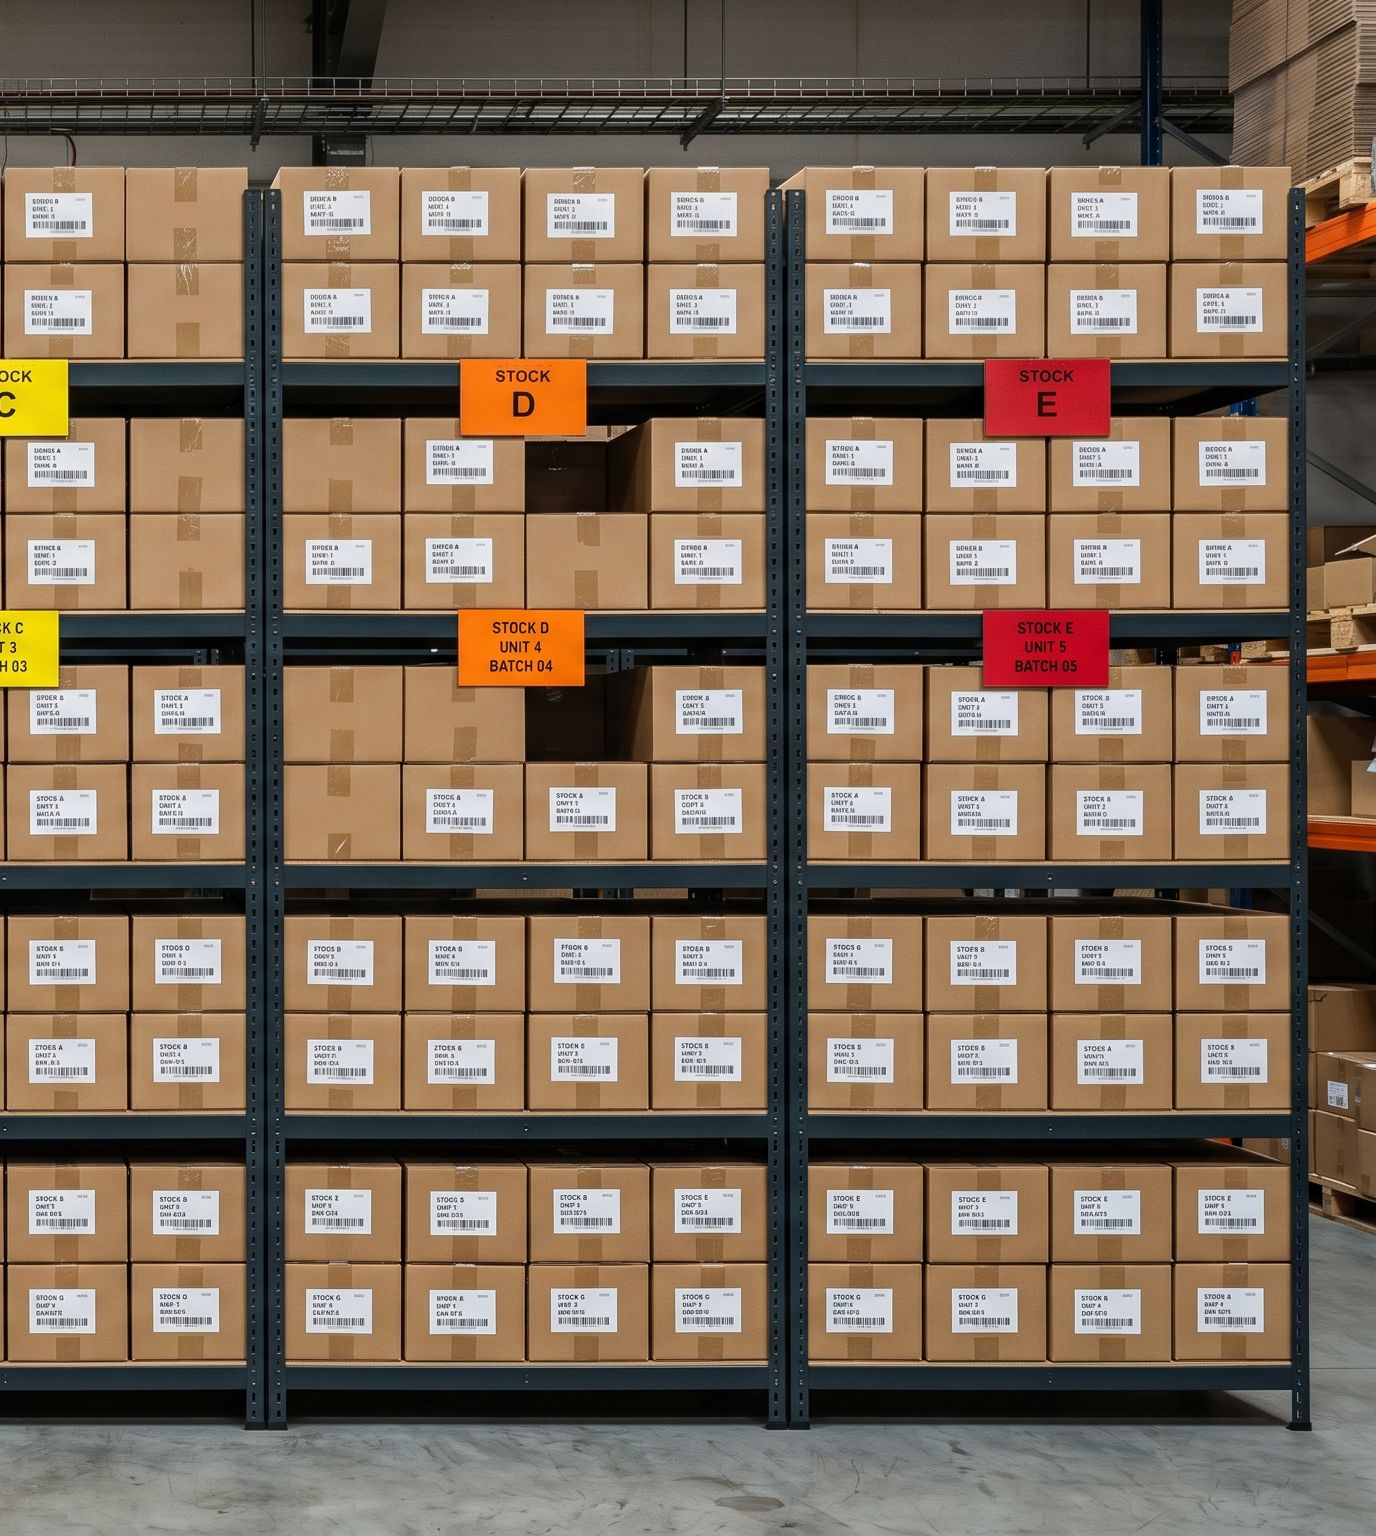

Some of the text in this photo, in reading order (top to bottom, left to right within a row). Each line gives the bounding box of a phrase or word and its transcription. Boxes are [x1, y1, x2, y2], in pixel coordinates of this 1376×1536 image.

[495, 369, 551, 383] STOCK
[1019, 369, 1074, 383] STOCK
[512, 390, 535, 418] D
[1037, 391, 1058, 418] E
[15, 621, 24, 635] C
[492, 621, 549, 635] STOCK D
[1017, 621, 1074, 635] STOCK E
[9, 641, 17, 654] 3
[499, 640, 542, 654] UNIT 4
[1024, 639, 1067, 654] UNIT 5
[11, 659, 28, 673] 03
[489, 659, 553, 673] BATCH 04
[1014, 659, 1078, 673] BATCH 05
